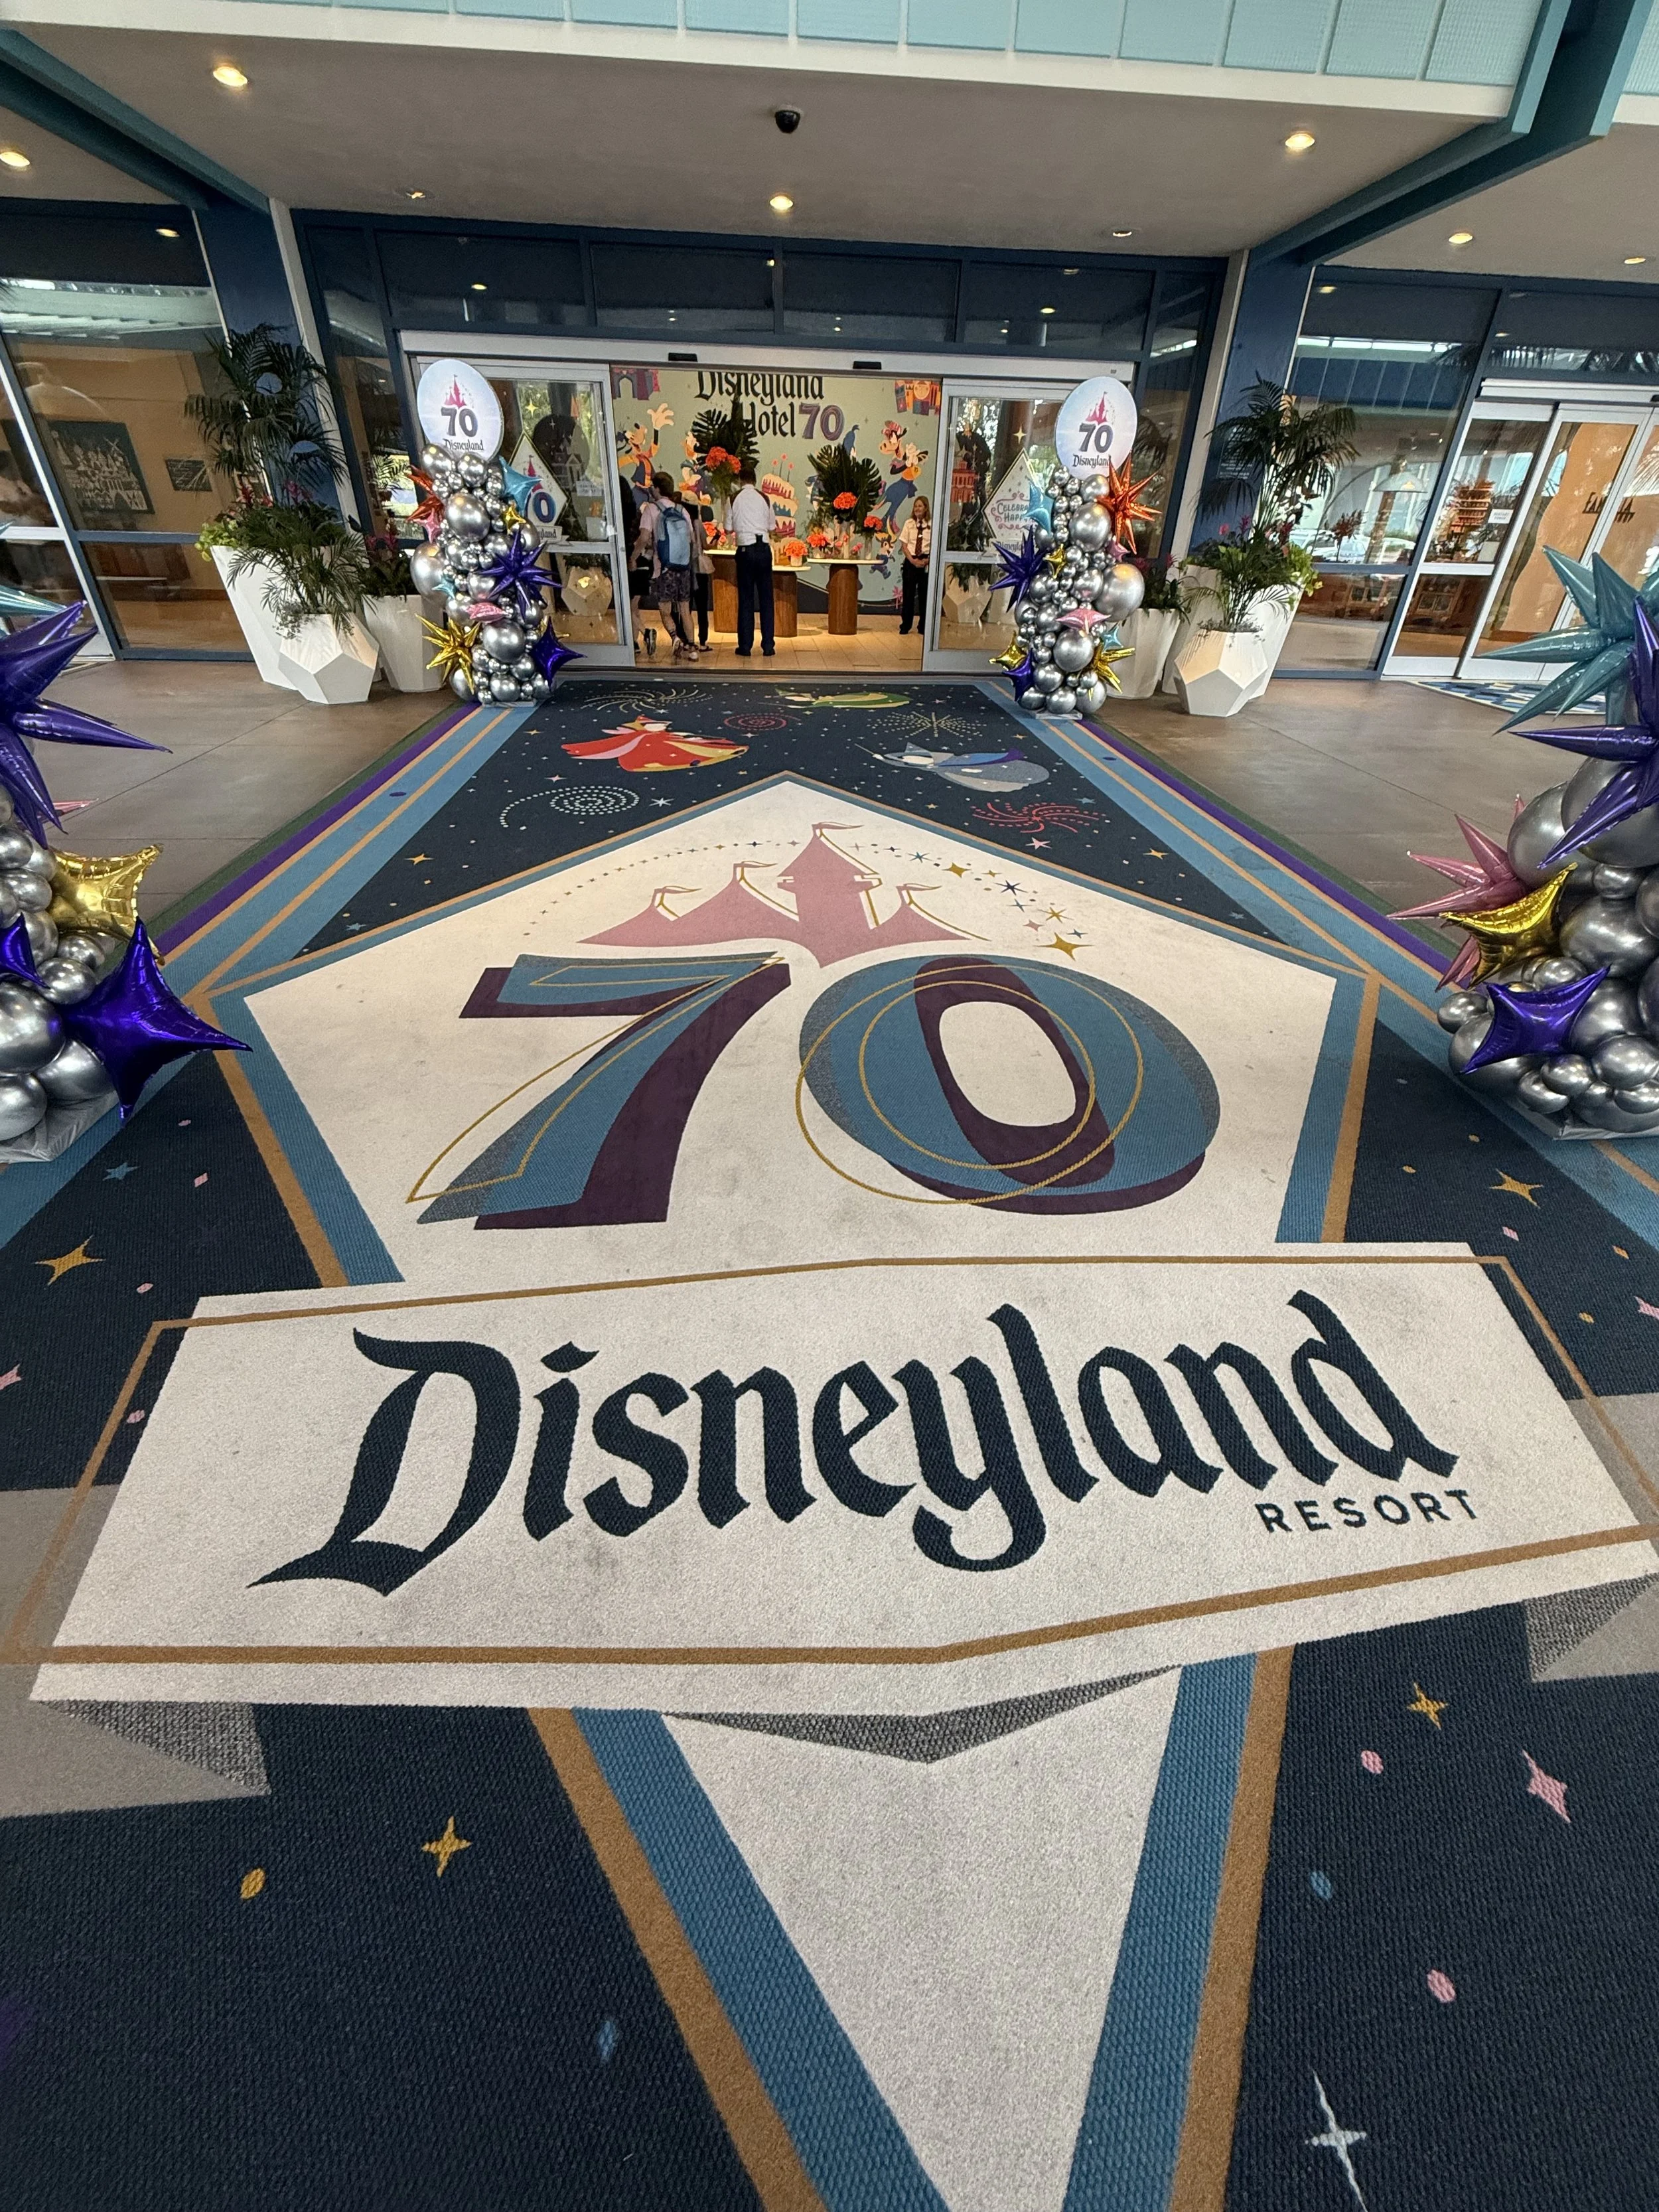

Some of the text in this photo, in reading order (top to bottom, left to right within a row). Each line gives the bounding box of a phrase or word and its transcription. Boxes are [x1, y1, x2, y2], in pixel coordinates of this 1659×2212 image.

[440, 406, 478, 437] 70
[798, 402, 845, 441] 70
[1078, 421, 1114, 453] 70
[442, 438, 484, 452] Disneyland
[997, 502, 1029, 514] CELEBRA
[405, 952, 1220, 1230] 70
[246, 1290, 1458, 1597] Disneyland
[1254, 1489, 1477, 1533] RESORT
